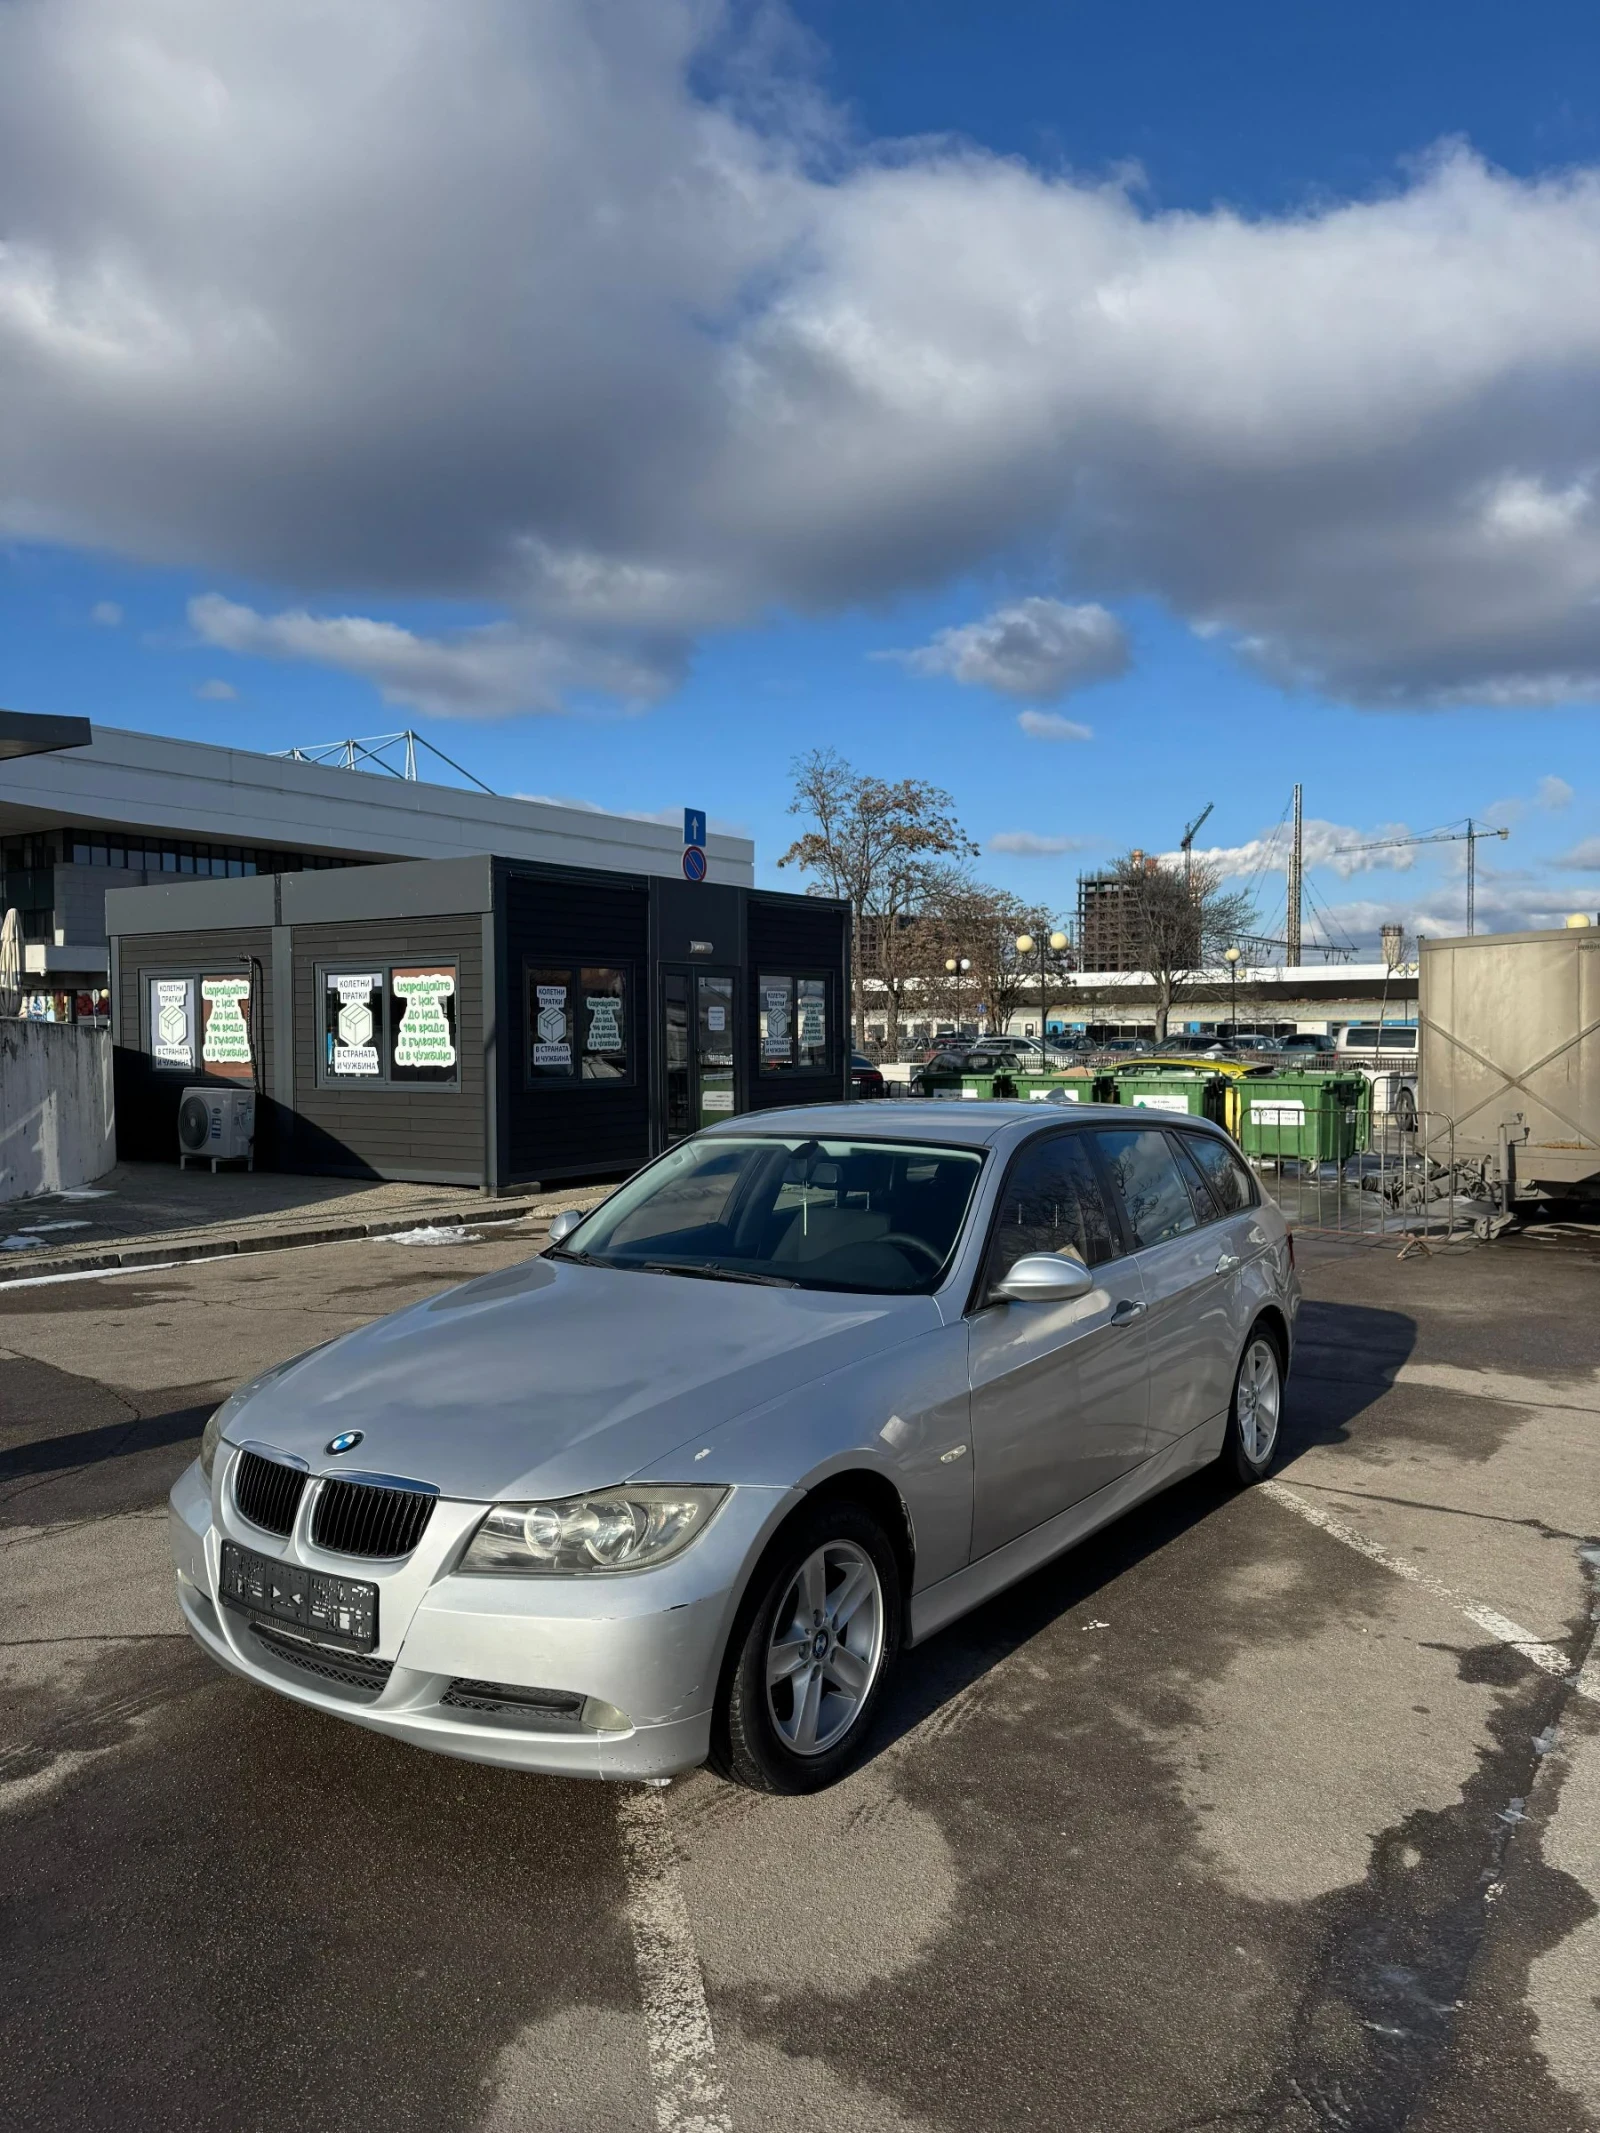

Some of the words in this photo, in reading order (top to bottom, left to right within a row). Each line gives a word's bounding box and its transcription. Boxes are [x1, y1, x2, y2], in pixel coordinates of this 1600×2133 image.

[339, 979, 370, 988] КОЛЕТНИ
[342, 992, 368, 1000] ПРАТКИ
[408, 1010, 420, 1020] до
[162, 1048, 189, 1056] СТРАНАТА
[337, 1050, 341, 1058] В
[342, 1050, 376, 1058] СТРАНАТА
[343, 1062, 376, 1070] ЧУЖБИНА
